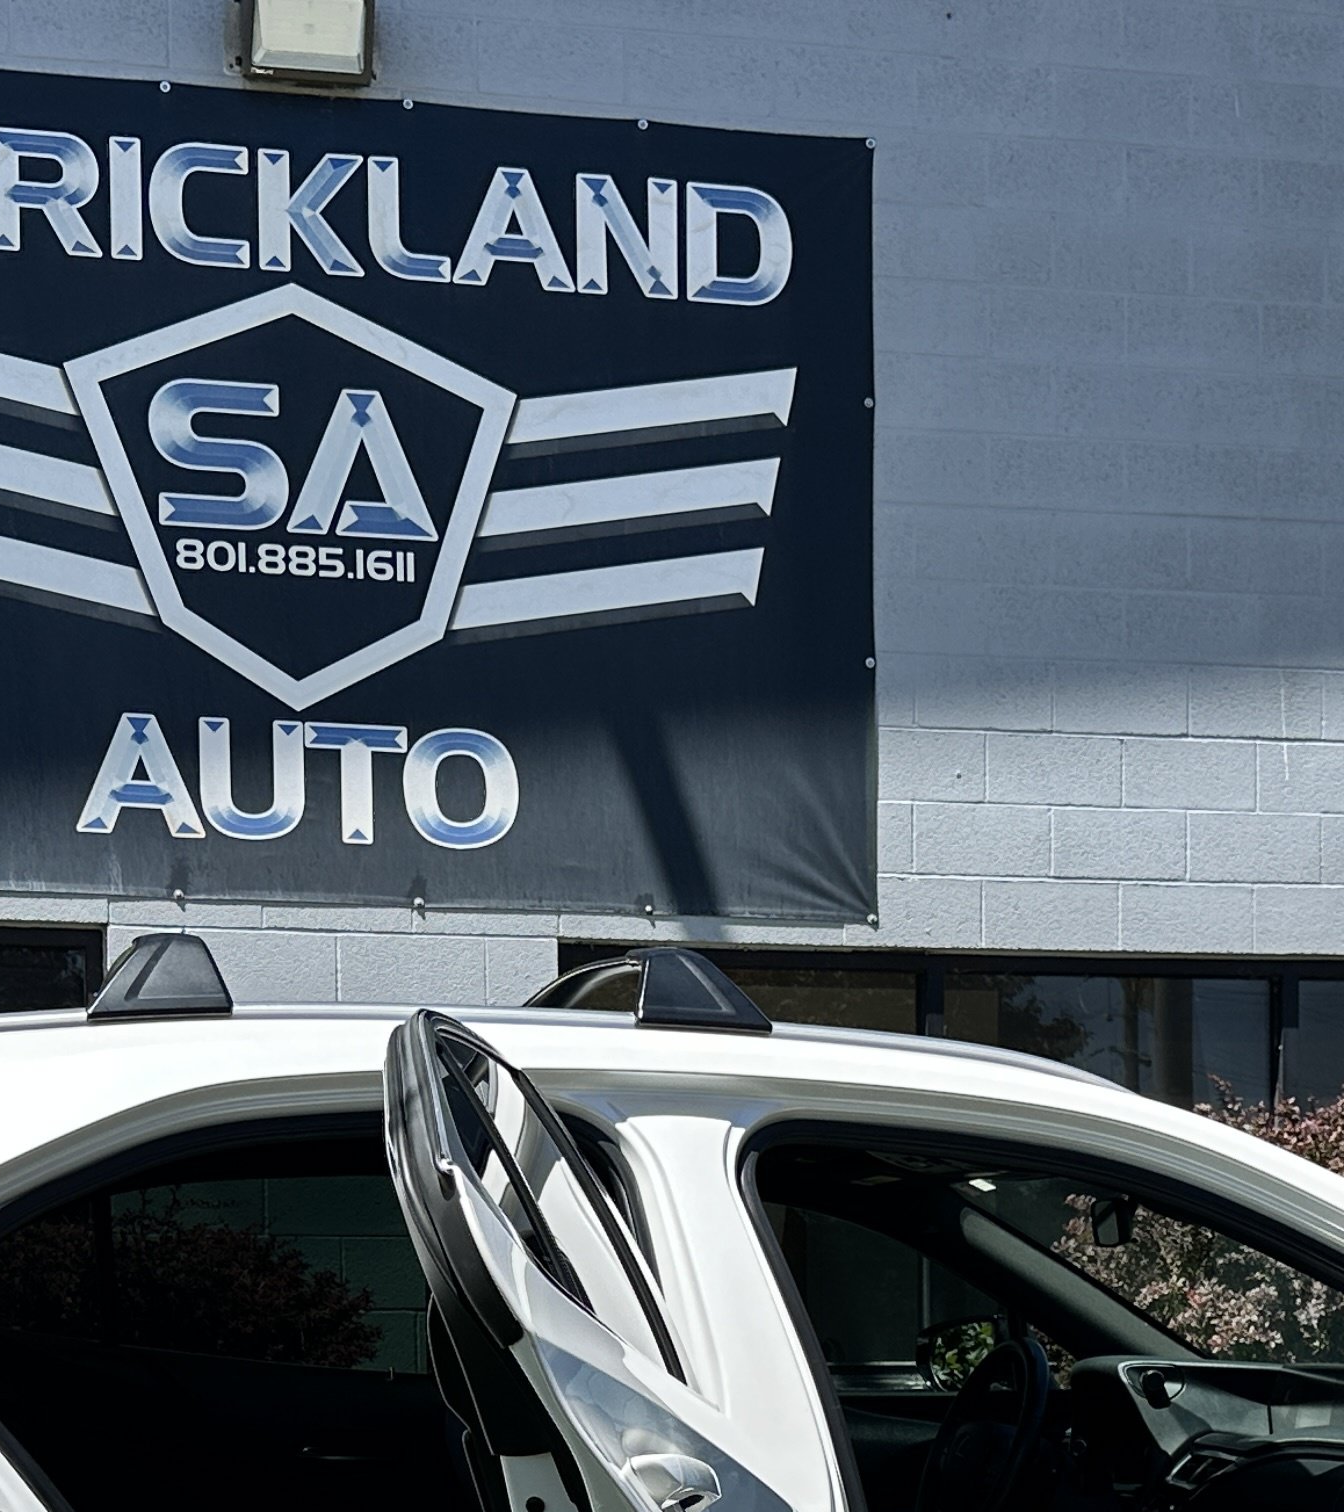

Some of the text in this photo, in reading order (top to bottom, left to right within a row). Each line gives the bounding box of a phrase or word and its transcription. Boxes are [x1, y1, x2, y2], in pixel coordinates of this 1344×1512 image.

[147, 377, 440, 543] SA
[174, 537, 416, 583] 801.885.1611
[74, 711, 520, 851] AUTO
